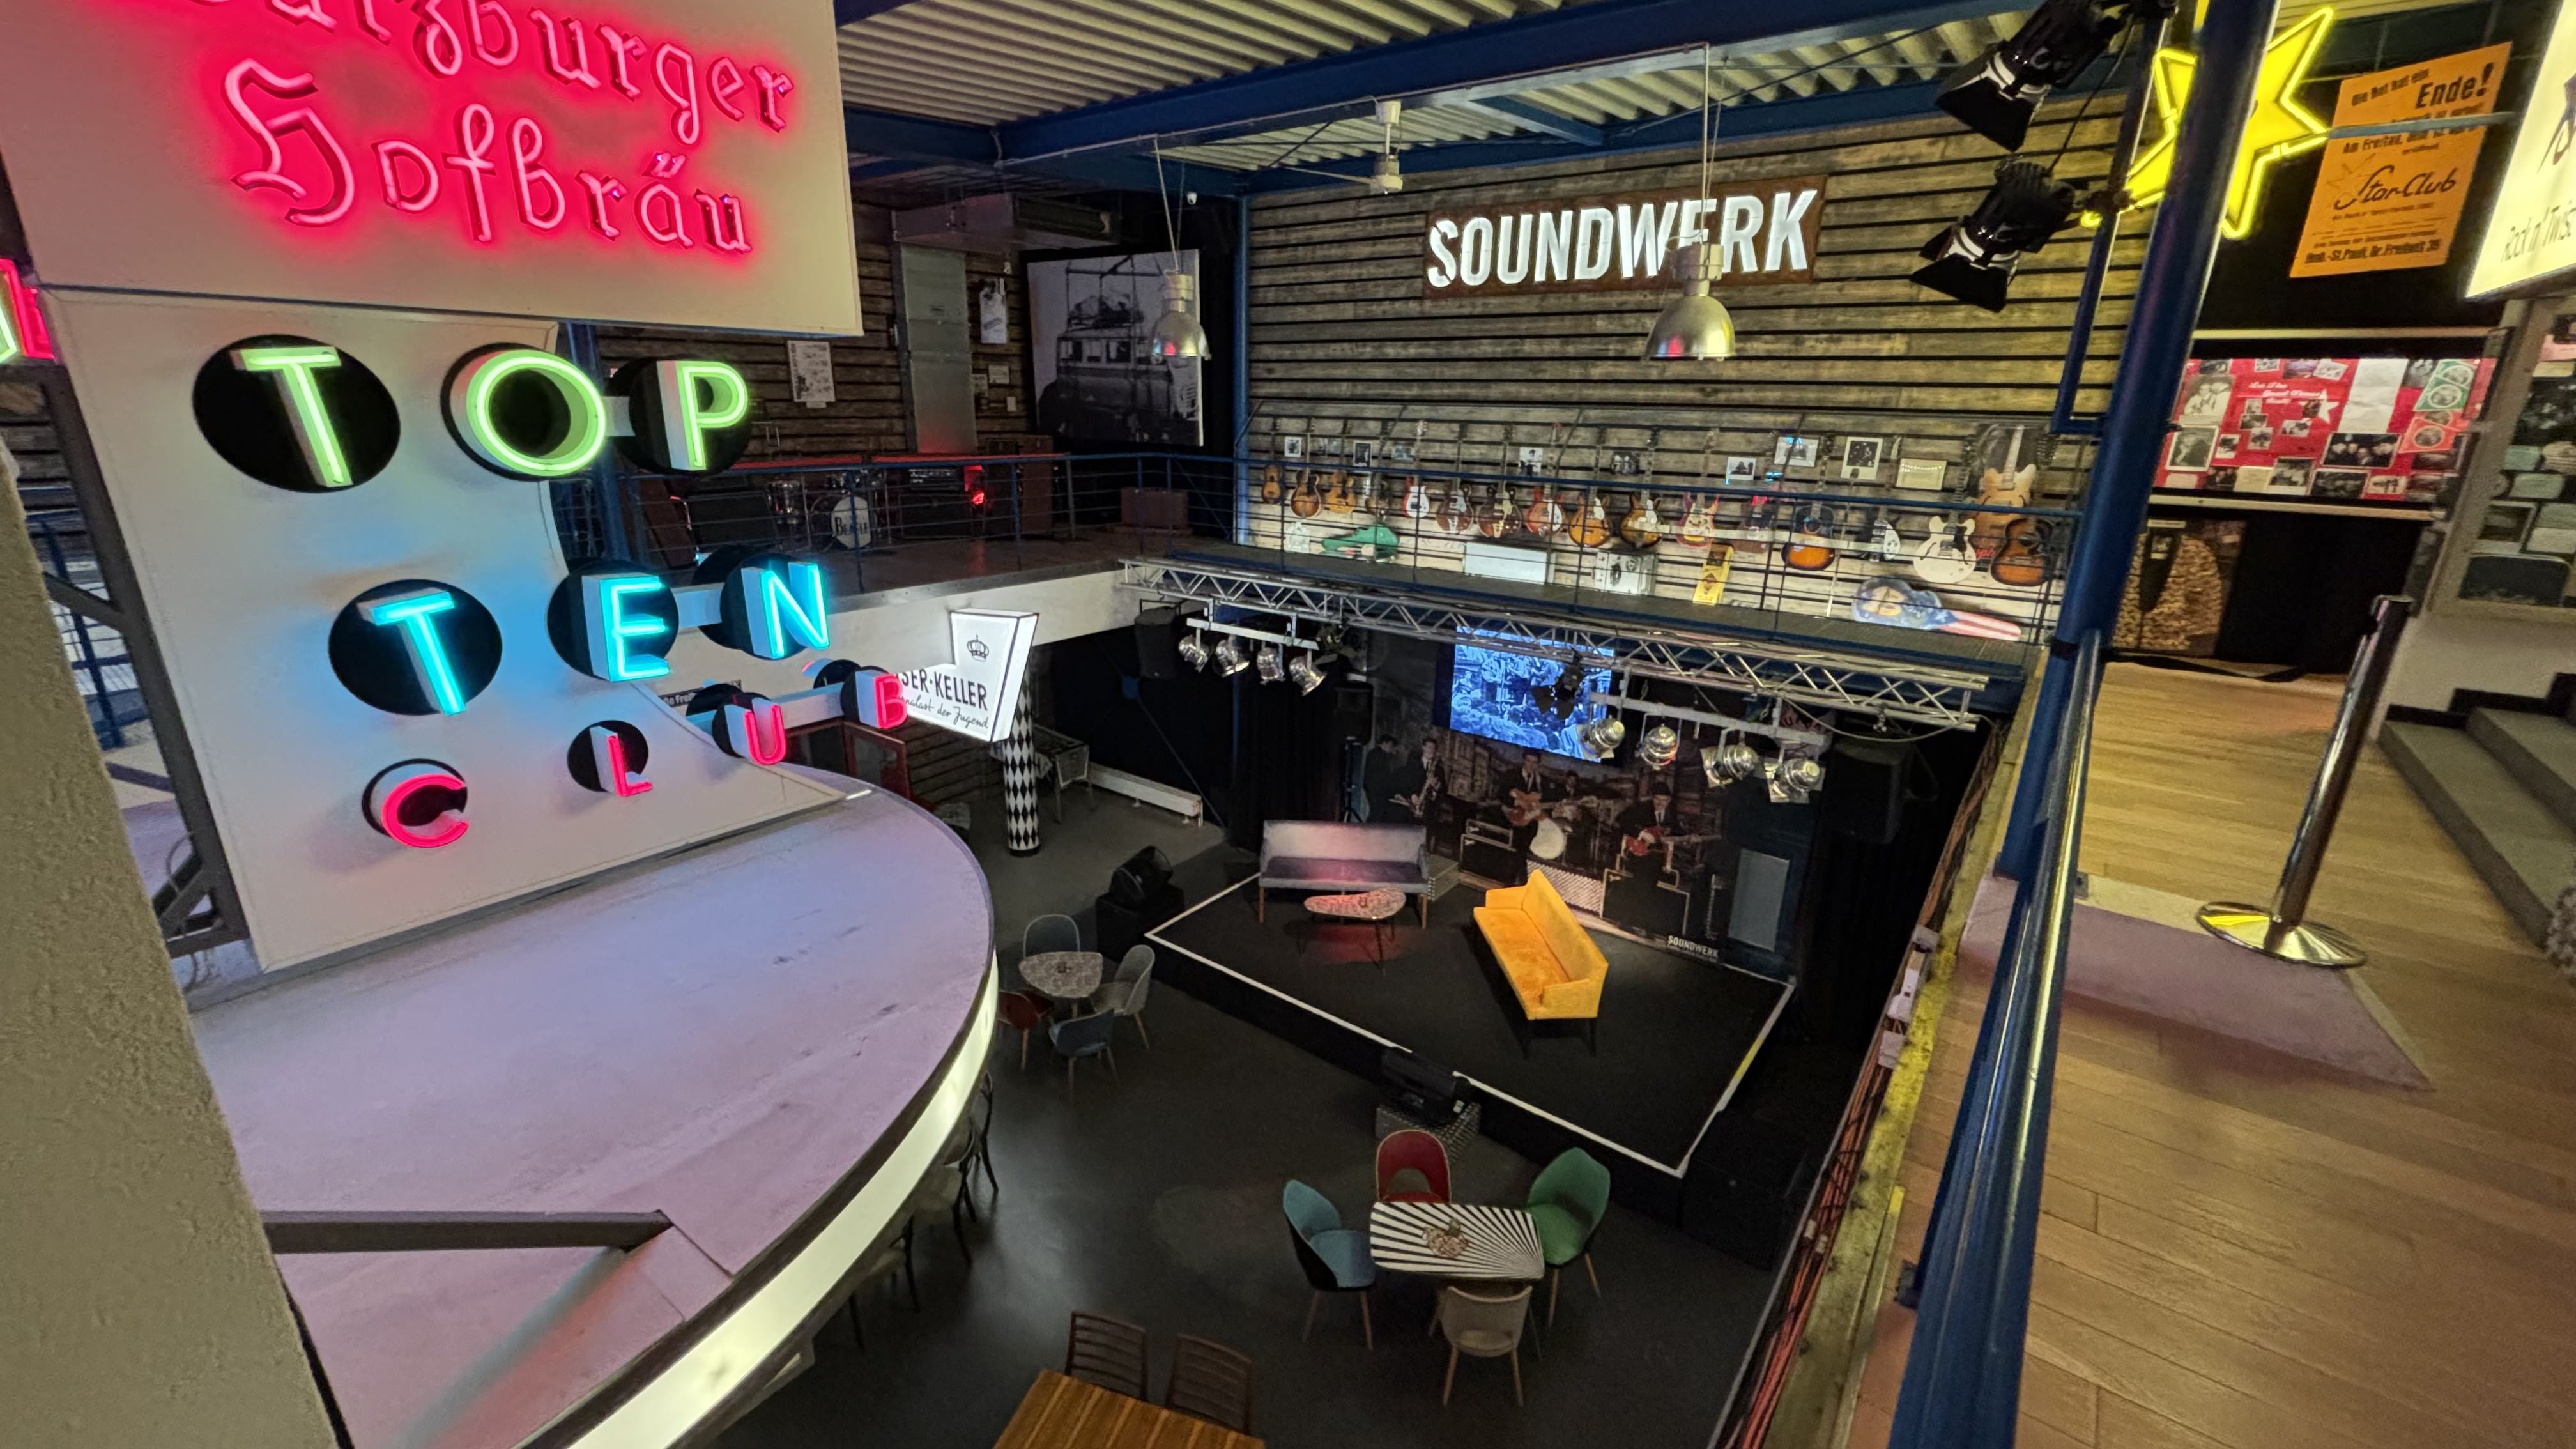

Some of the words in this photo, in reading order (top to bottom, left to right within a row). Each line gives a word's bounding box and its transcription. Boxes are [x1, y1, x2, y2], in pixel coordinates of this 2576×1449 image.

[2415, 62, 2494, 109] Ende!
[224, 57, 753, 254] Hofbräu
[2333, 164, 2458, 210] Star-Club
[1427, 189, 1818, 288] SOUNDWERK
[233, 345, 749, 489] TOP
[365, 562, 831, 716] TEN
[381, 673, 908, 850] CLUB
[937, 703, 951, 717] der
[953, 706, 989, 729] Jugend
[1668, 935, 1719, 958] SOUNDWERK
